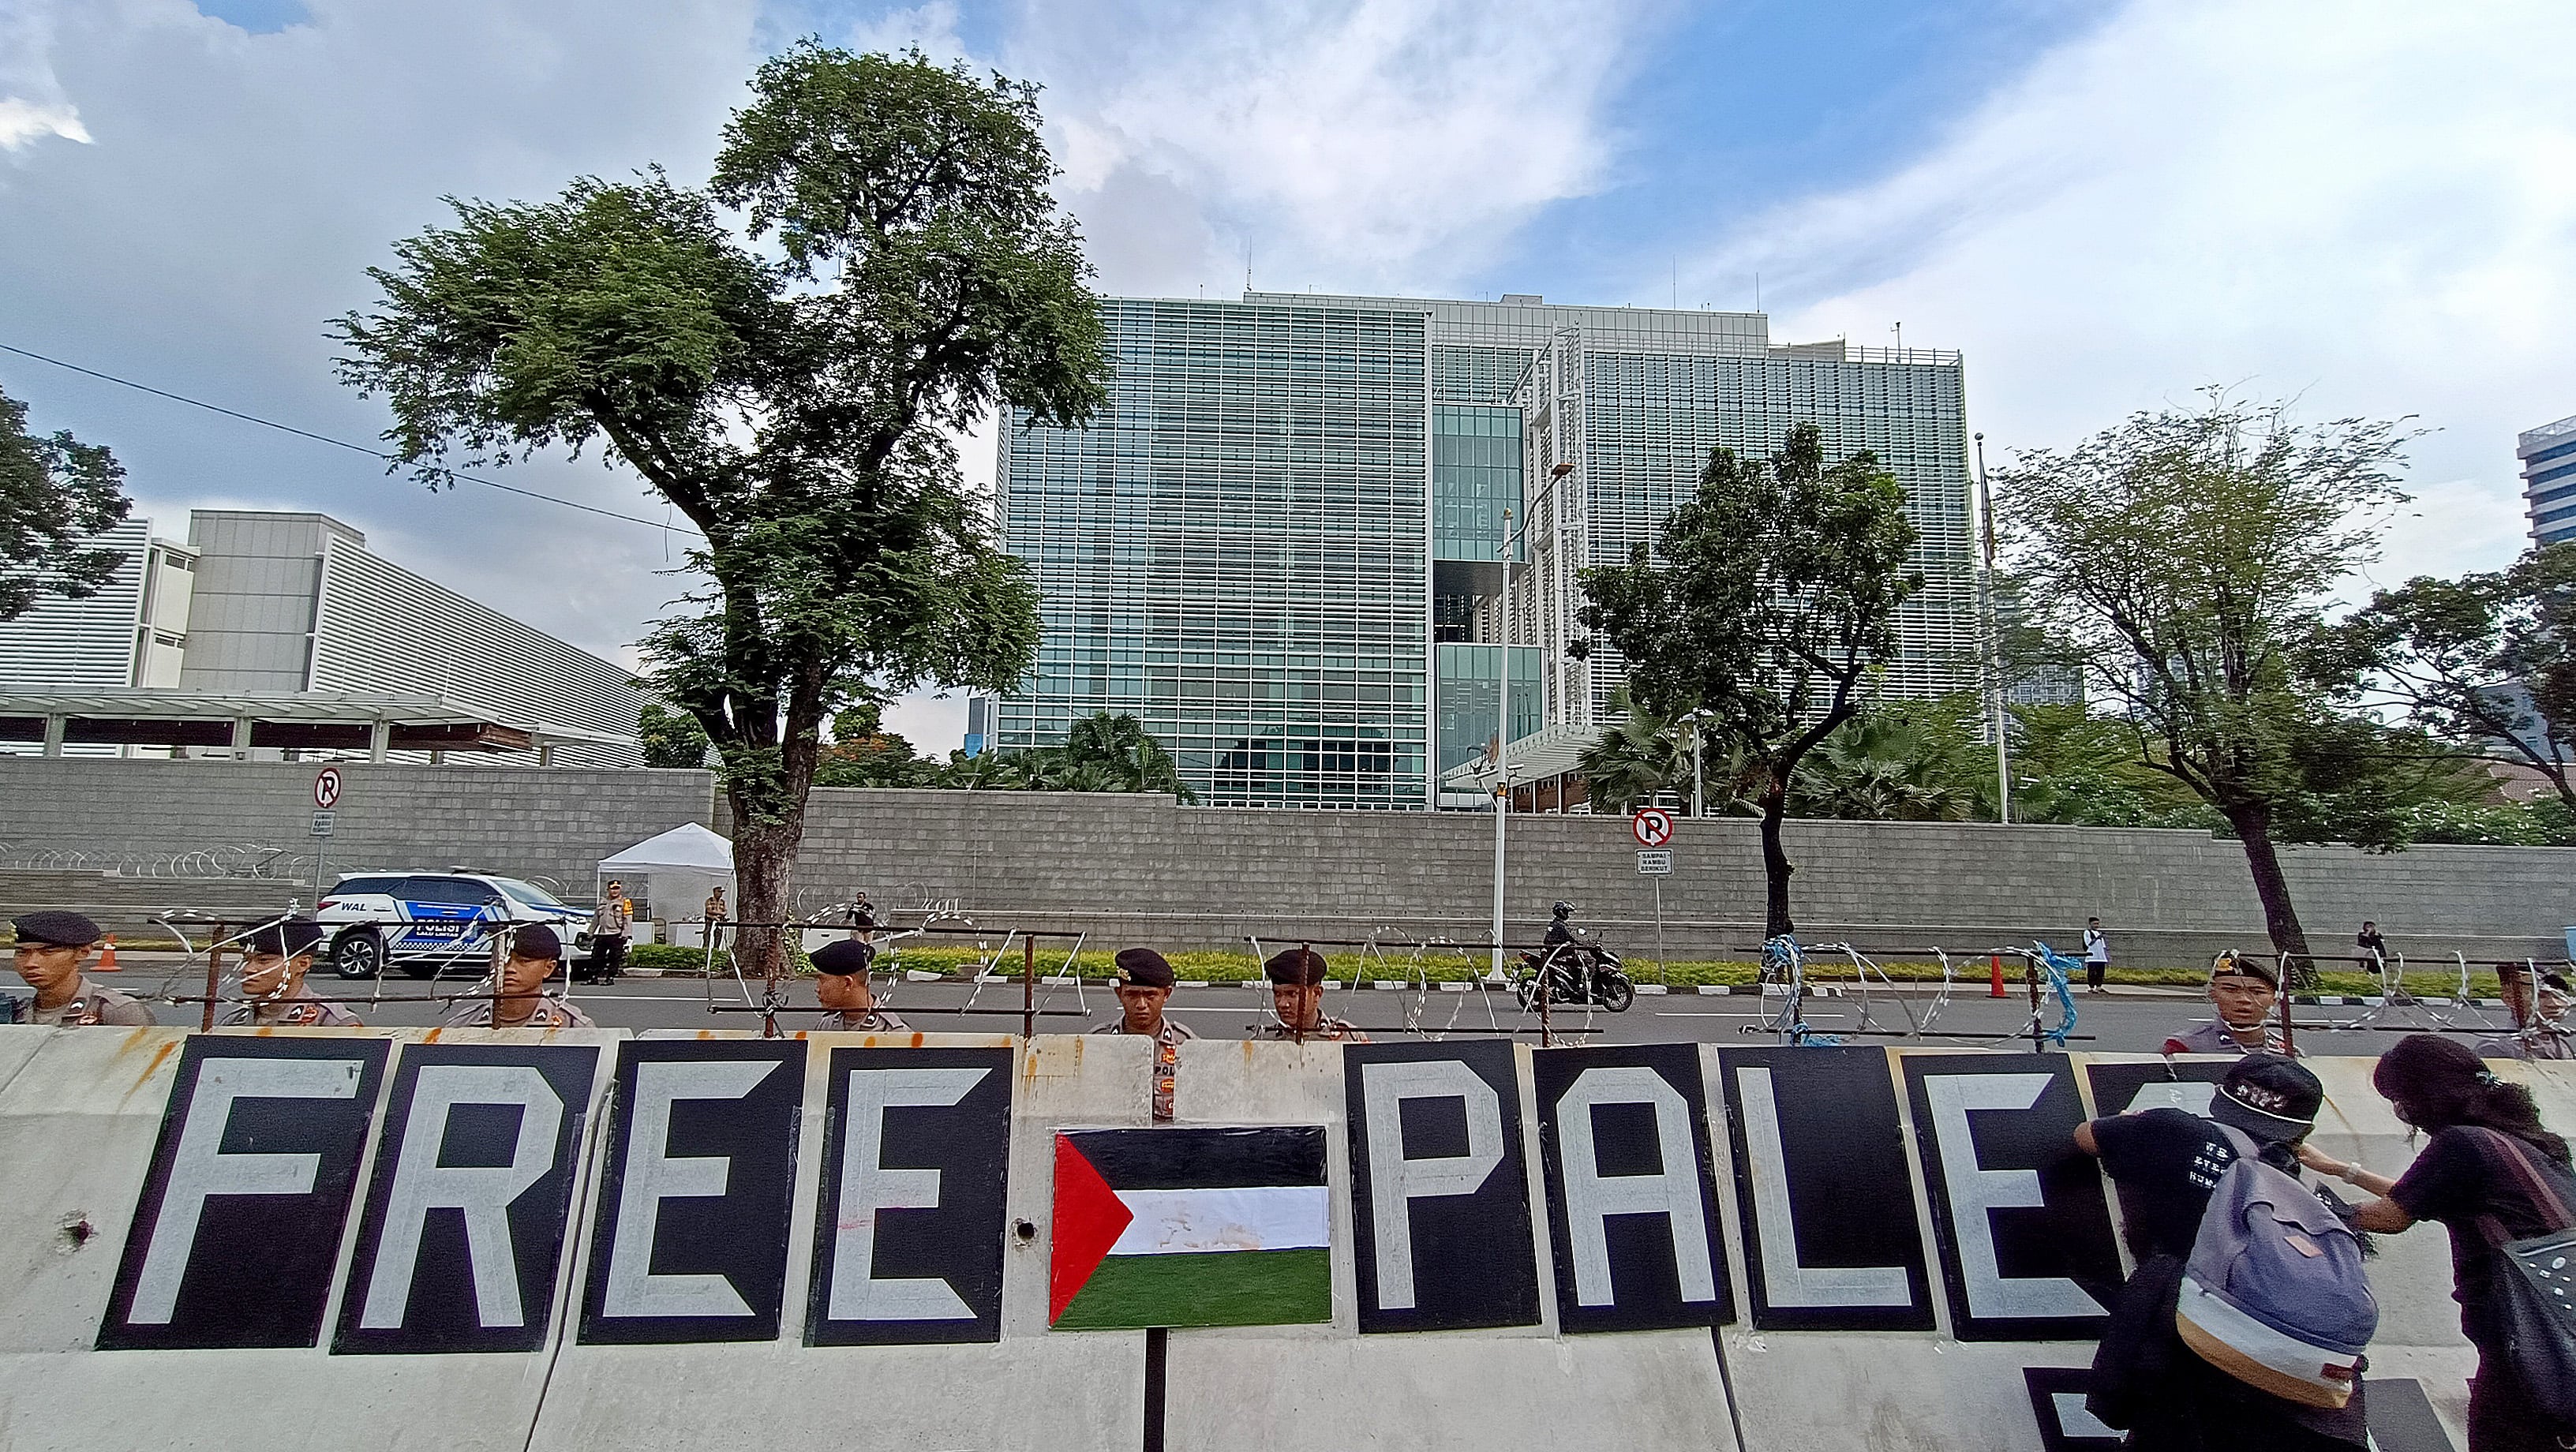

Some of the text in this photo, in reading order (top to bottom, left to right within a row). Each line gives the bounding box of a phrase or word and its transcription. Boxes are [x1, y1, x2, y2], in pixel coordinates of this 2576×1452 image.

[321, 777, 335, 800] P
[1645, 817, 1663, 840] P
[341, 902, 367, 911] WAL
[417, 919, 459, 933] POLISI
[127, 1057, 2216, 1330] FREE PALE
